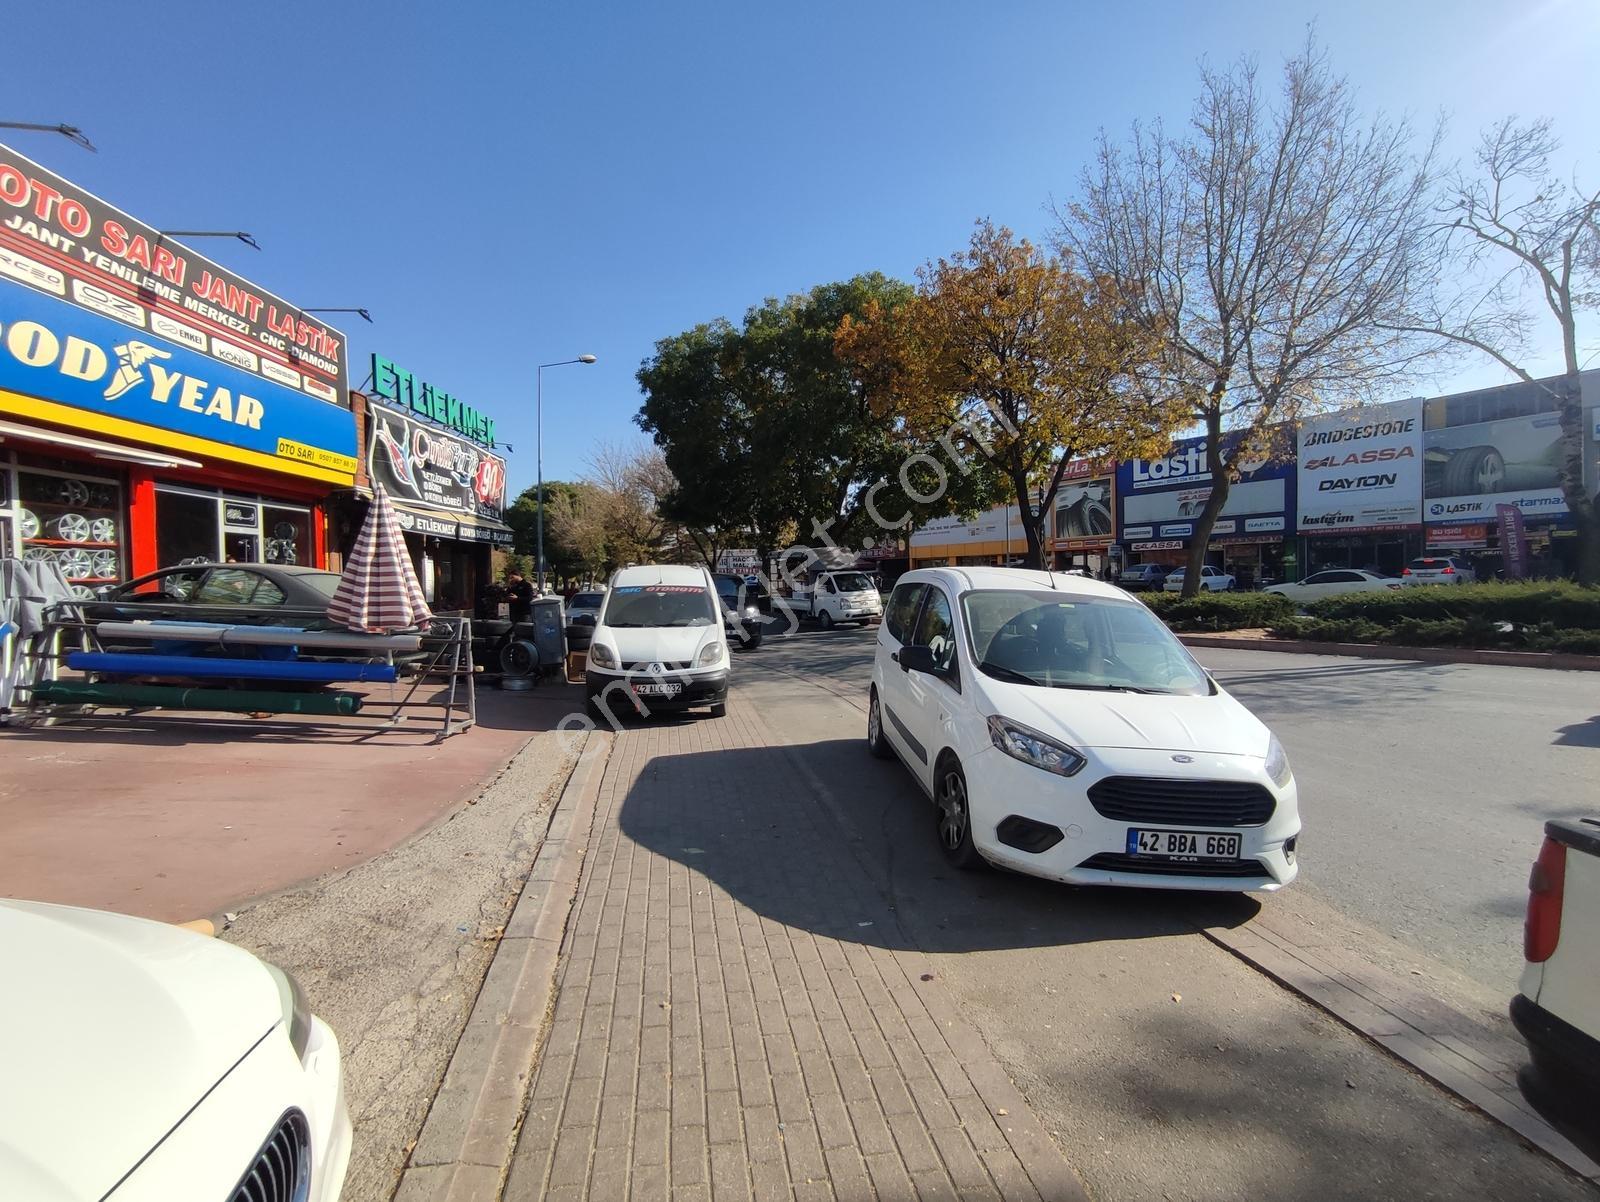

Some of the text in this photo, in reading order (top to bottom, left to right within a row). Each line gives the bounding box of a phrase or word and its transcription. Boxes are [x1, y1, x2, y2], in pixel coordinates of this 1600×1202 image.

[0, 163, 91, 238] OTO
[101, 219, 187, 287] SARI
[192, 270, 264, 323] JANT
[5, 215, 76, 253] JANT
[260, 330, 286, 351] CNC
[149, 362, 265, 431] YEAR
[1304, 418, 1416, 447] BRIDGESTONE
[279, 442, 295, 455] OTO
[297, 447, 315, 460] SARI
[1327, 445, 1415, 468] LASSA
[1318, 473, 1397, 492] DAYTON
[636, 683, 682, 694] 42 ALC 032
[1138, 832, 1237, 856] 42 BBA 668
